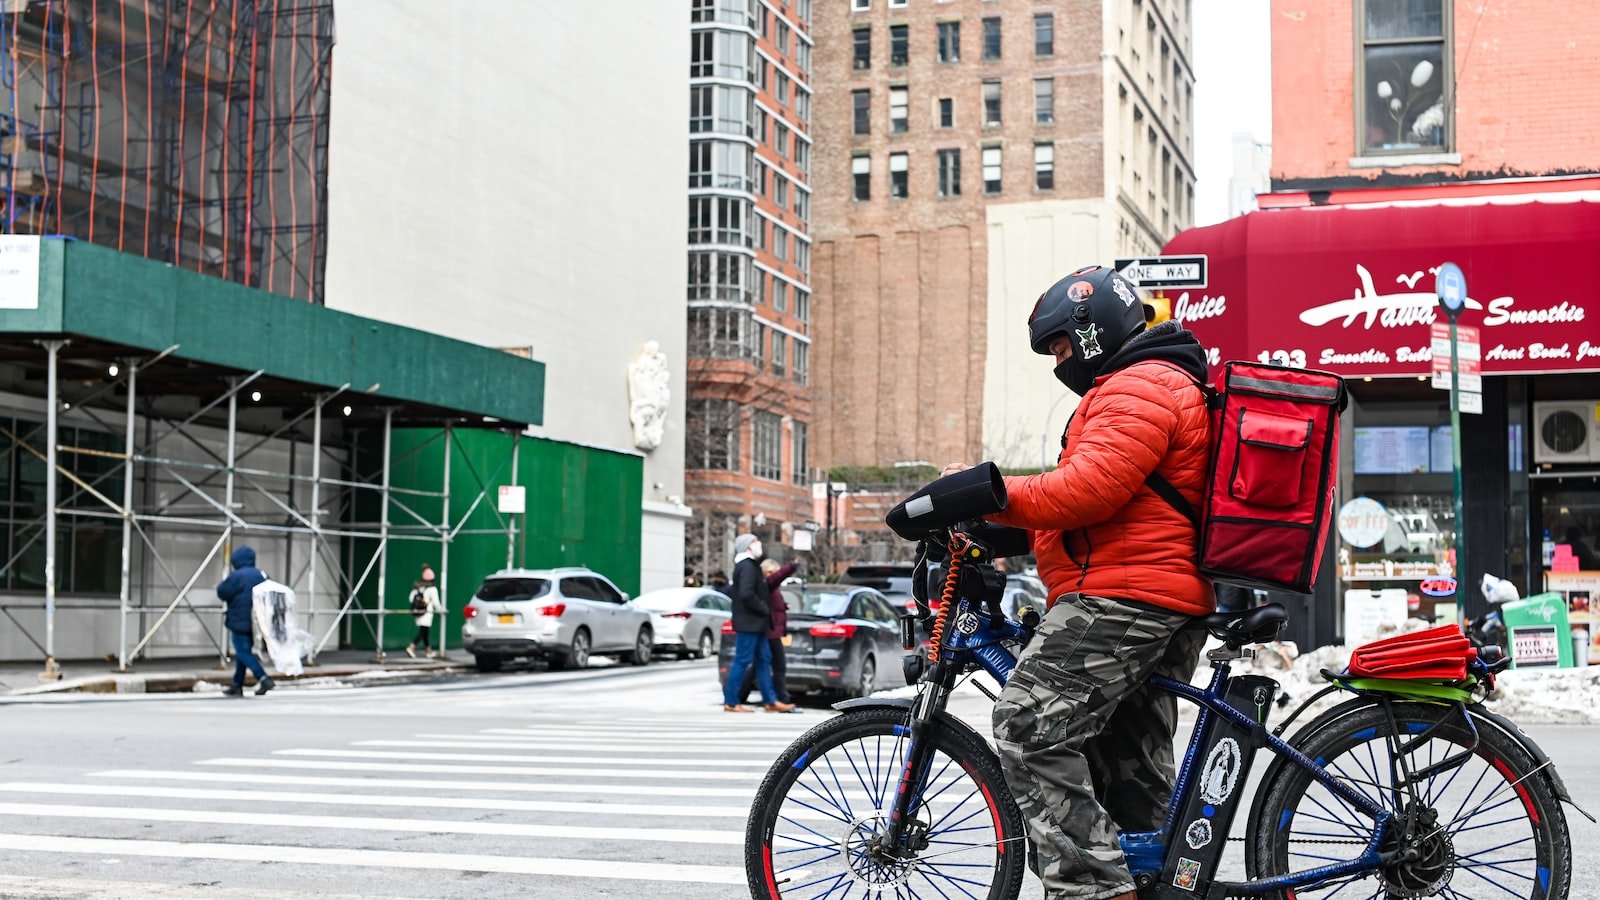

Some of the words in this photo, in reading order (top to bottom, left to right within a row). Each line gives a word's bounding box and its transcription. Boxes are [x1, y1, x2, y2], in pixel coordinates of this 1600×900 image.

[1127, 267, 1153, 279] ONE
[1166, 266, 1193, 278] WAY
[1174, 291, 1227, 323] Juice
[1483, 297, 1585, 326] Smoothie
[1395, 346, 1433, 362] Bubb
[1485, 344, 1525, 361] Acai
[1528, 342, 1571, 359] Bowl,
[1420, 580, 1457, 592] OPEN
[1515, 640, 1541, 648] OUR
[1516, 647, 1554, 655] TOWN
